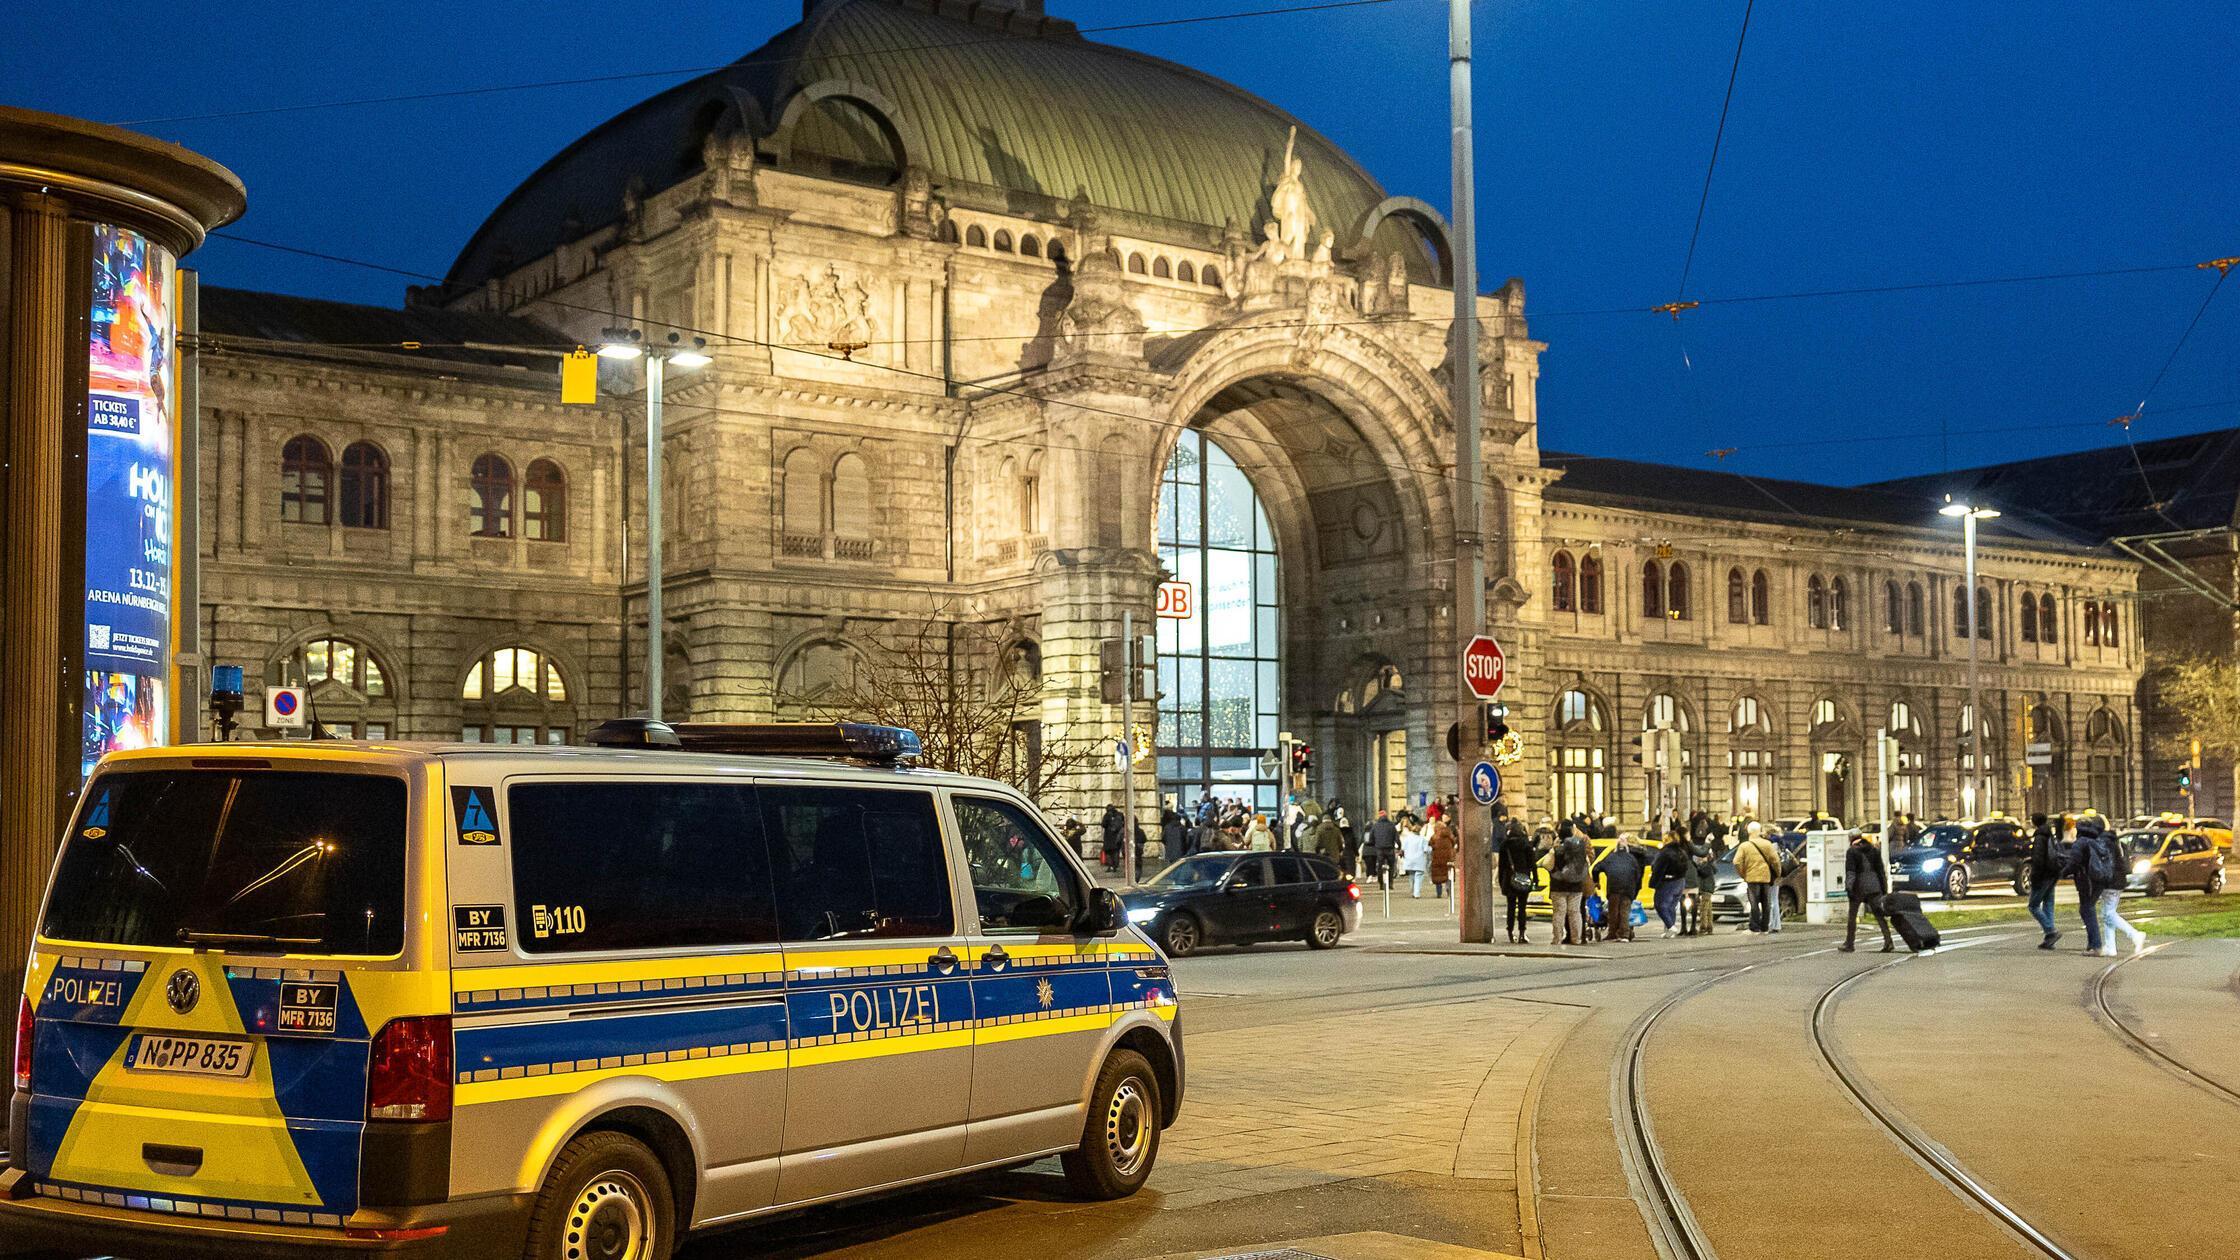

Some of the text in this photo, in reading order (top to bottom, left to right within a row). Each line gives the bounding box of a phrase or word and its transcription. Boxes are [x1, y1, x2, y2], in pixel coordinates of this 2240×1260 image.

[92, 400, 128, 414] TICKETS
[93, 413, 109, 425] AB
[88, 589, 121, 604] ARENA
[1156, 587, 1188, 613] DB
[1468, 653, 1502, 680] STOP
[468, 805, 481, 826] 7
[469, 910, 491, 925] BY
[553, 905, 586, 935] 110
[458, 930, 506, 947] MFR 7136
[53, 978, 122, 1007] POLIZEI
[296, 988, 321, 1005] BY
[280, 1009, 333, 1027] MFR 7136
[829, 985, 940, 1033] POLIZEI
[200, 1043, 243, 1071] 835
